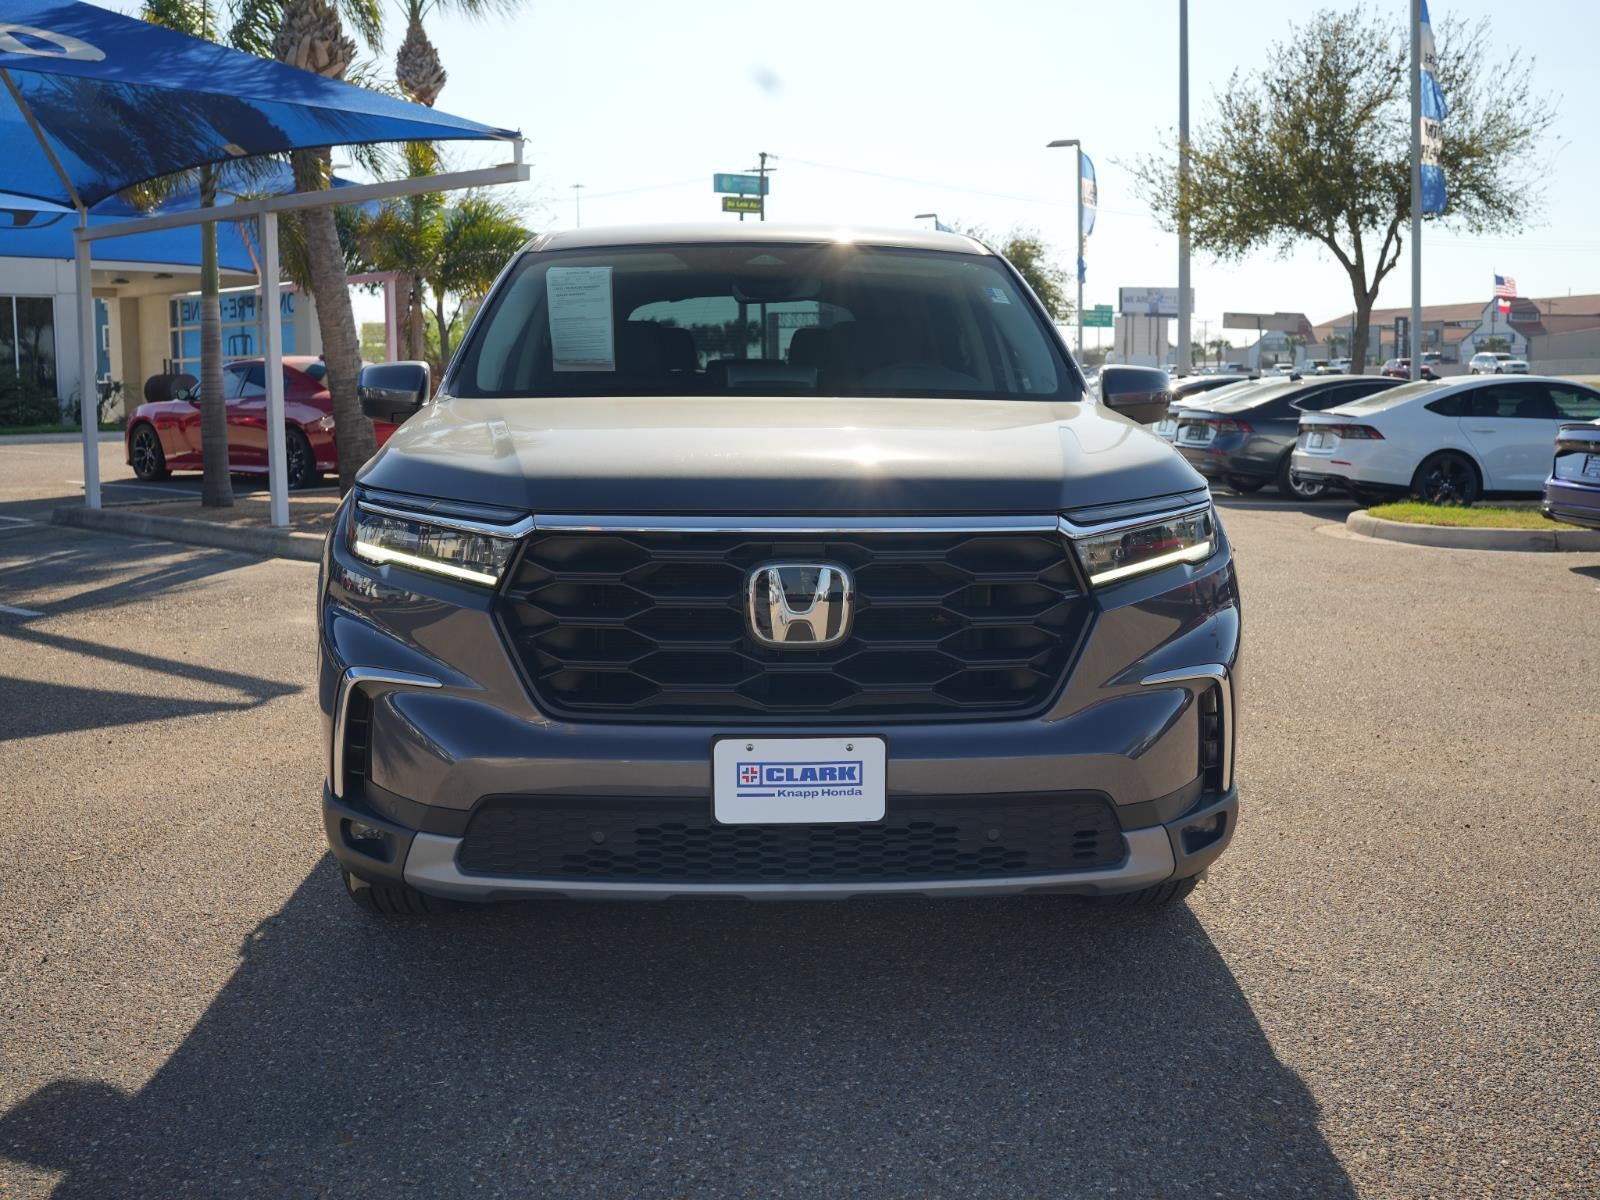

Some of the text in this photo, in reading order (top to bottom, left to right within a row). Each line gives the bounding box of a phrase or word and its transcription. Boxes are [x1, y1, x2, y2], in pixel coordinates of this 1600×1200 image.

[766, 767, 856, 782] CLARK
[777, 787, 862, 799] Knapp Honda
